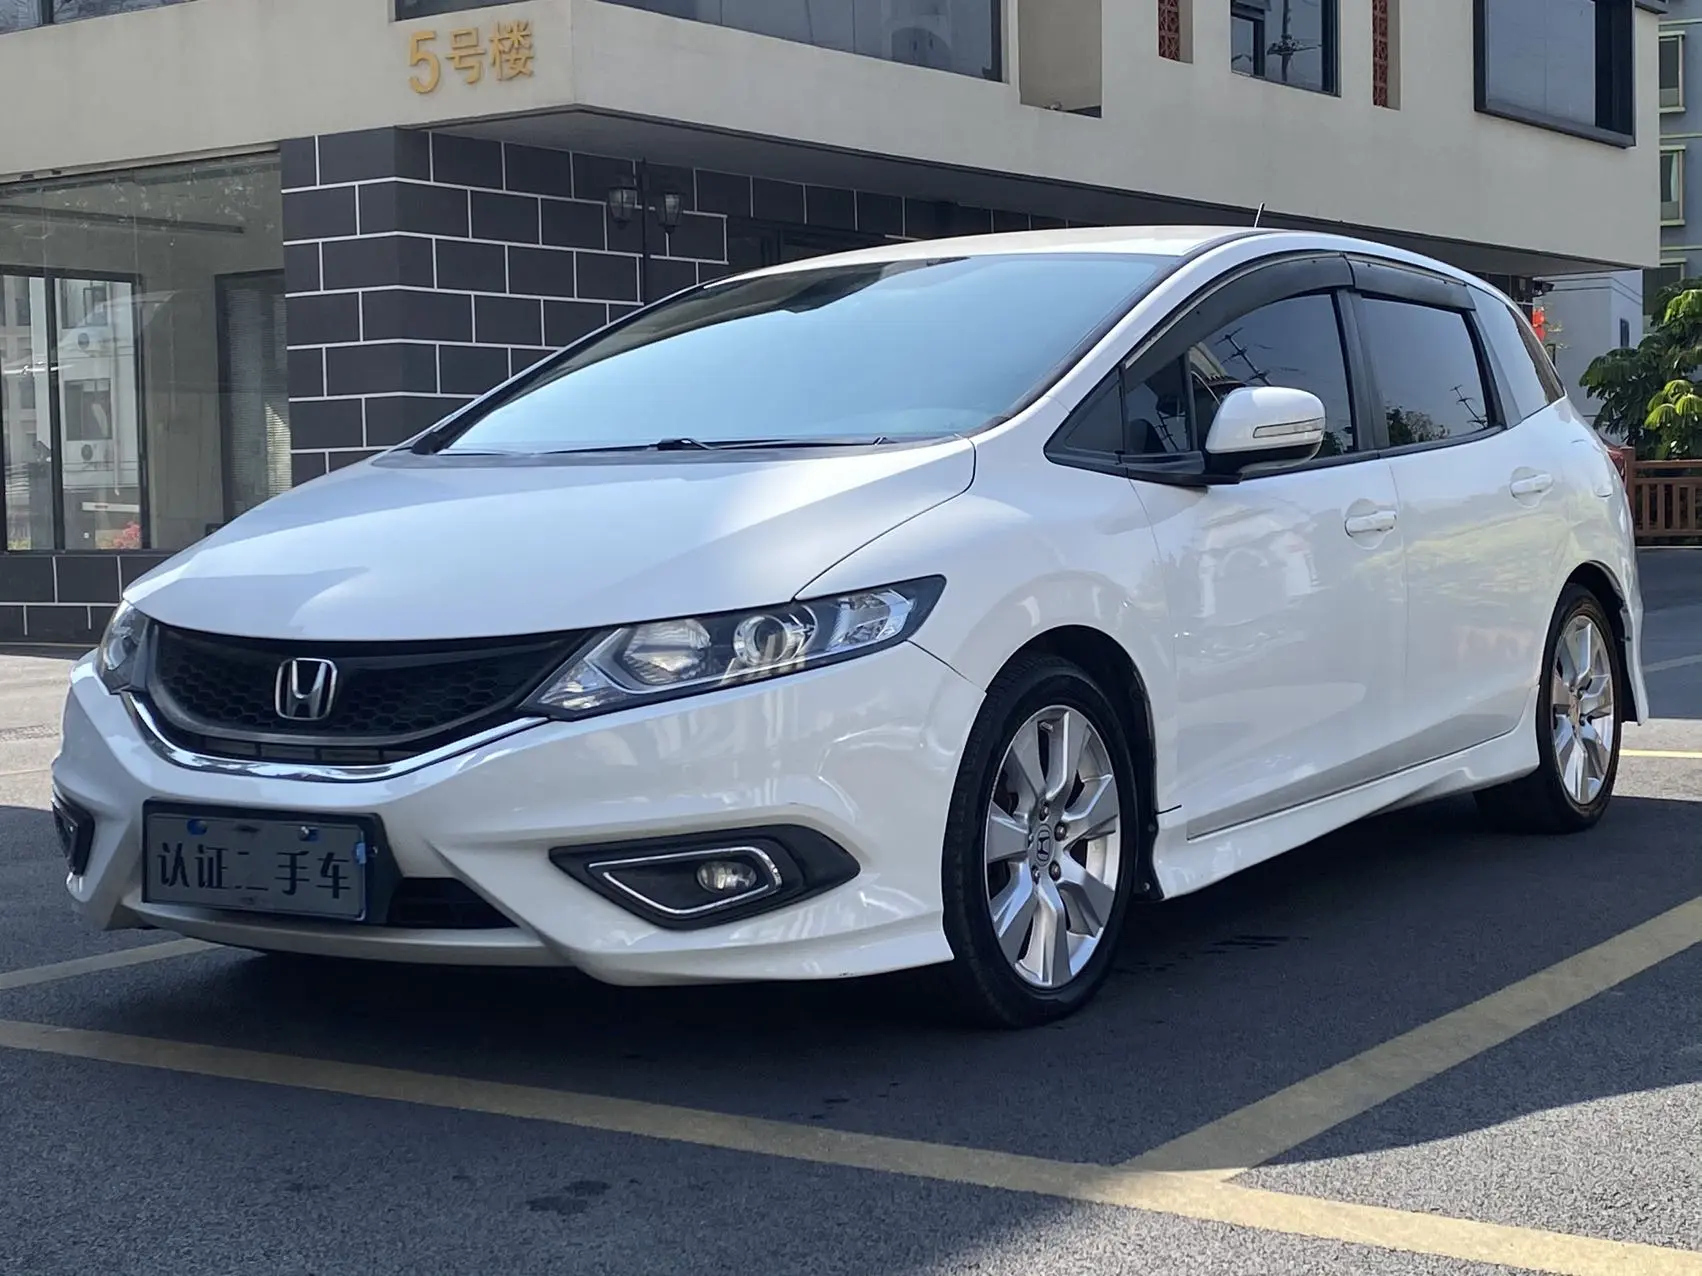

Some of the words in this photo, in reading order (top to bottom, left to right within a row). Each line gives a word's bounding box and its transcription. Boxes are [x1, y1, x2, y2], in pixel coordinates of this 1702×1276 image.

[409, 20, 535, 94] 5号楼
[157, 842, 352, 899] 认证二手车
